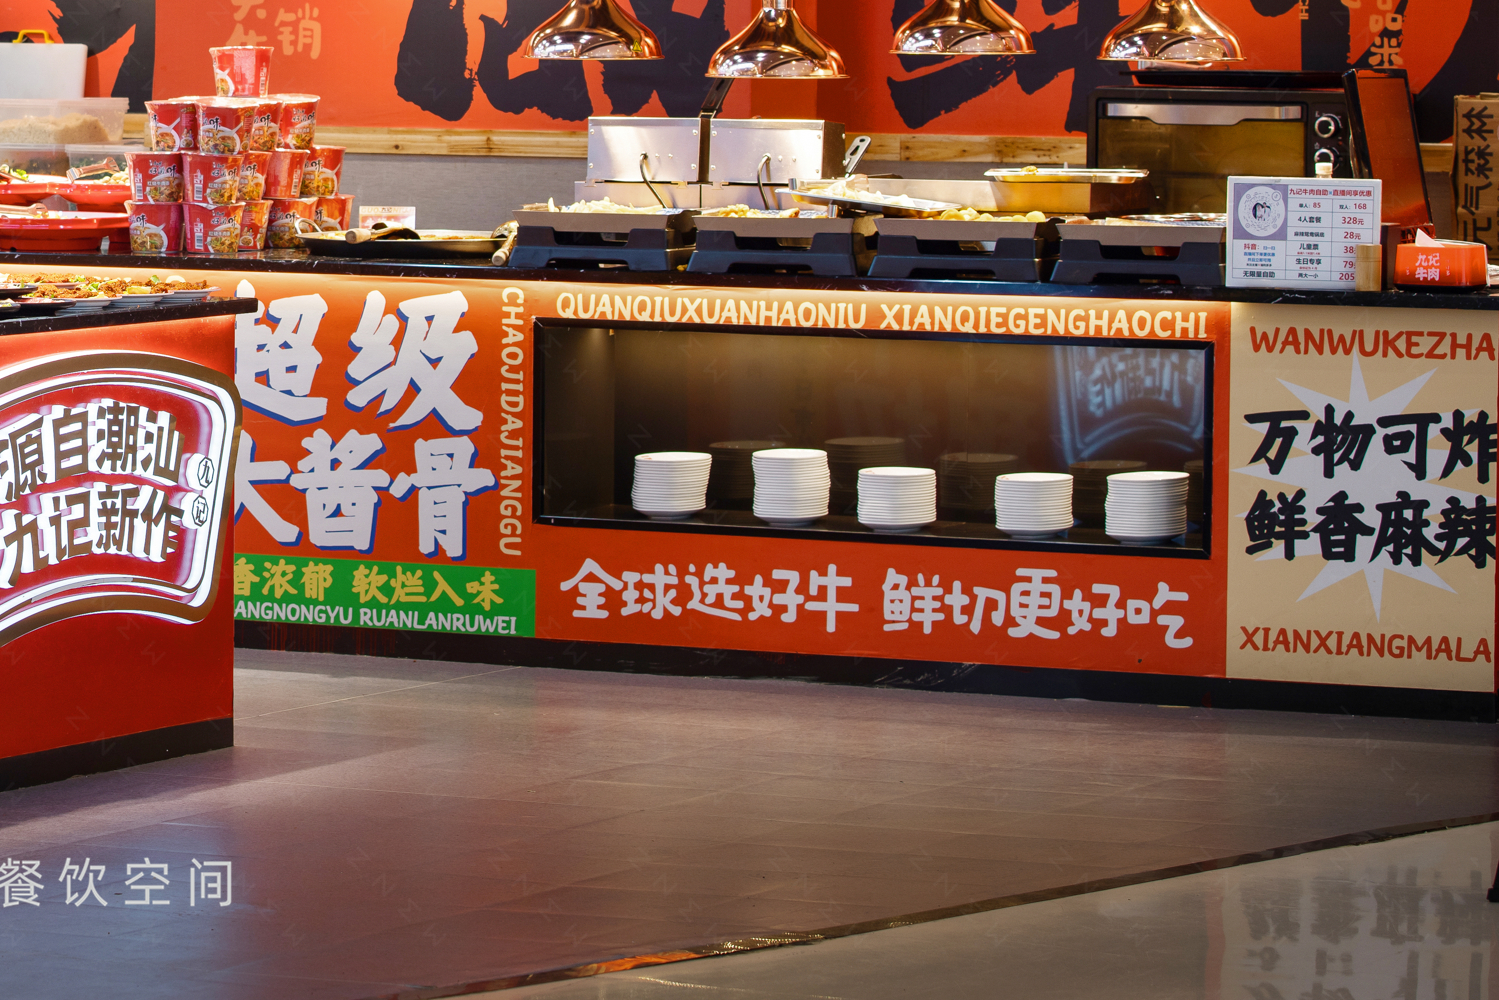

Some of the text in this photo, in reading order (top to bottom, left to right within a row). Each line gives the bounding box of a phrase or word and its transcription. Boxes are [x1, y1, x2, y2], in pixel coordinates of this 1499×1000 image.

[1341, 216, 1364, 226] 328元
[1343, 231, 1362, 241] 28元
[1295, 257, 1322, 266] 生日专享
[1342, 260, 1356, 269] 79
[1343, 245, 1356, 254] 38
[1415, 253, 1440, 267] 九记
[1242, 270, 1276, 279] 无限量自助
[1415, 267, 1440, 281] 牛肉
[555, 292, 1209, 340] QUANQIUXUANHAONIU XIANQIEGENGHAOCHI
[1248, 325, 1497, 361] WANWUKEZHA
[499, 286, 525, 557] CHAOJIDAJIANGGU
[1243, 403, 1497, 484] 万物可炸
[3, 484, 185, 588] 九记新作
[1244, 488, 1497, 570] 鲜香麻辣
[351, 564, 504, 612] 软烂入味
[559, 557, 1194, 649] 全球选好牛 鲜切更好吃
[359, 606, 517, 635] RUANLANRUWEI
[1238, 625, 1492, 664] XIANXIANGMALA
